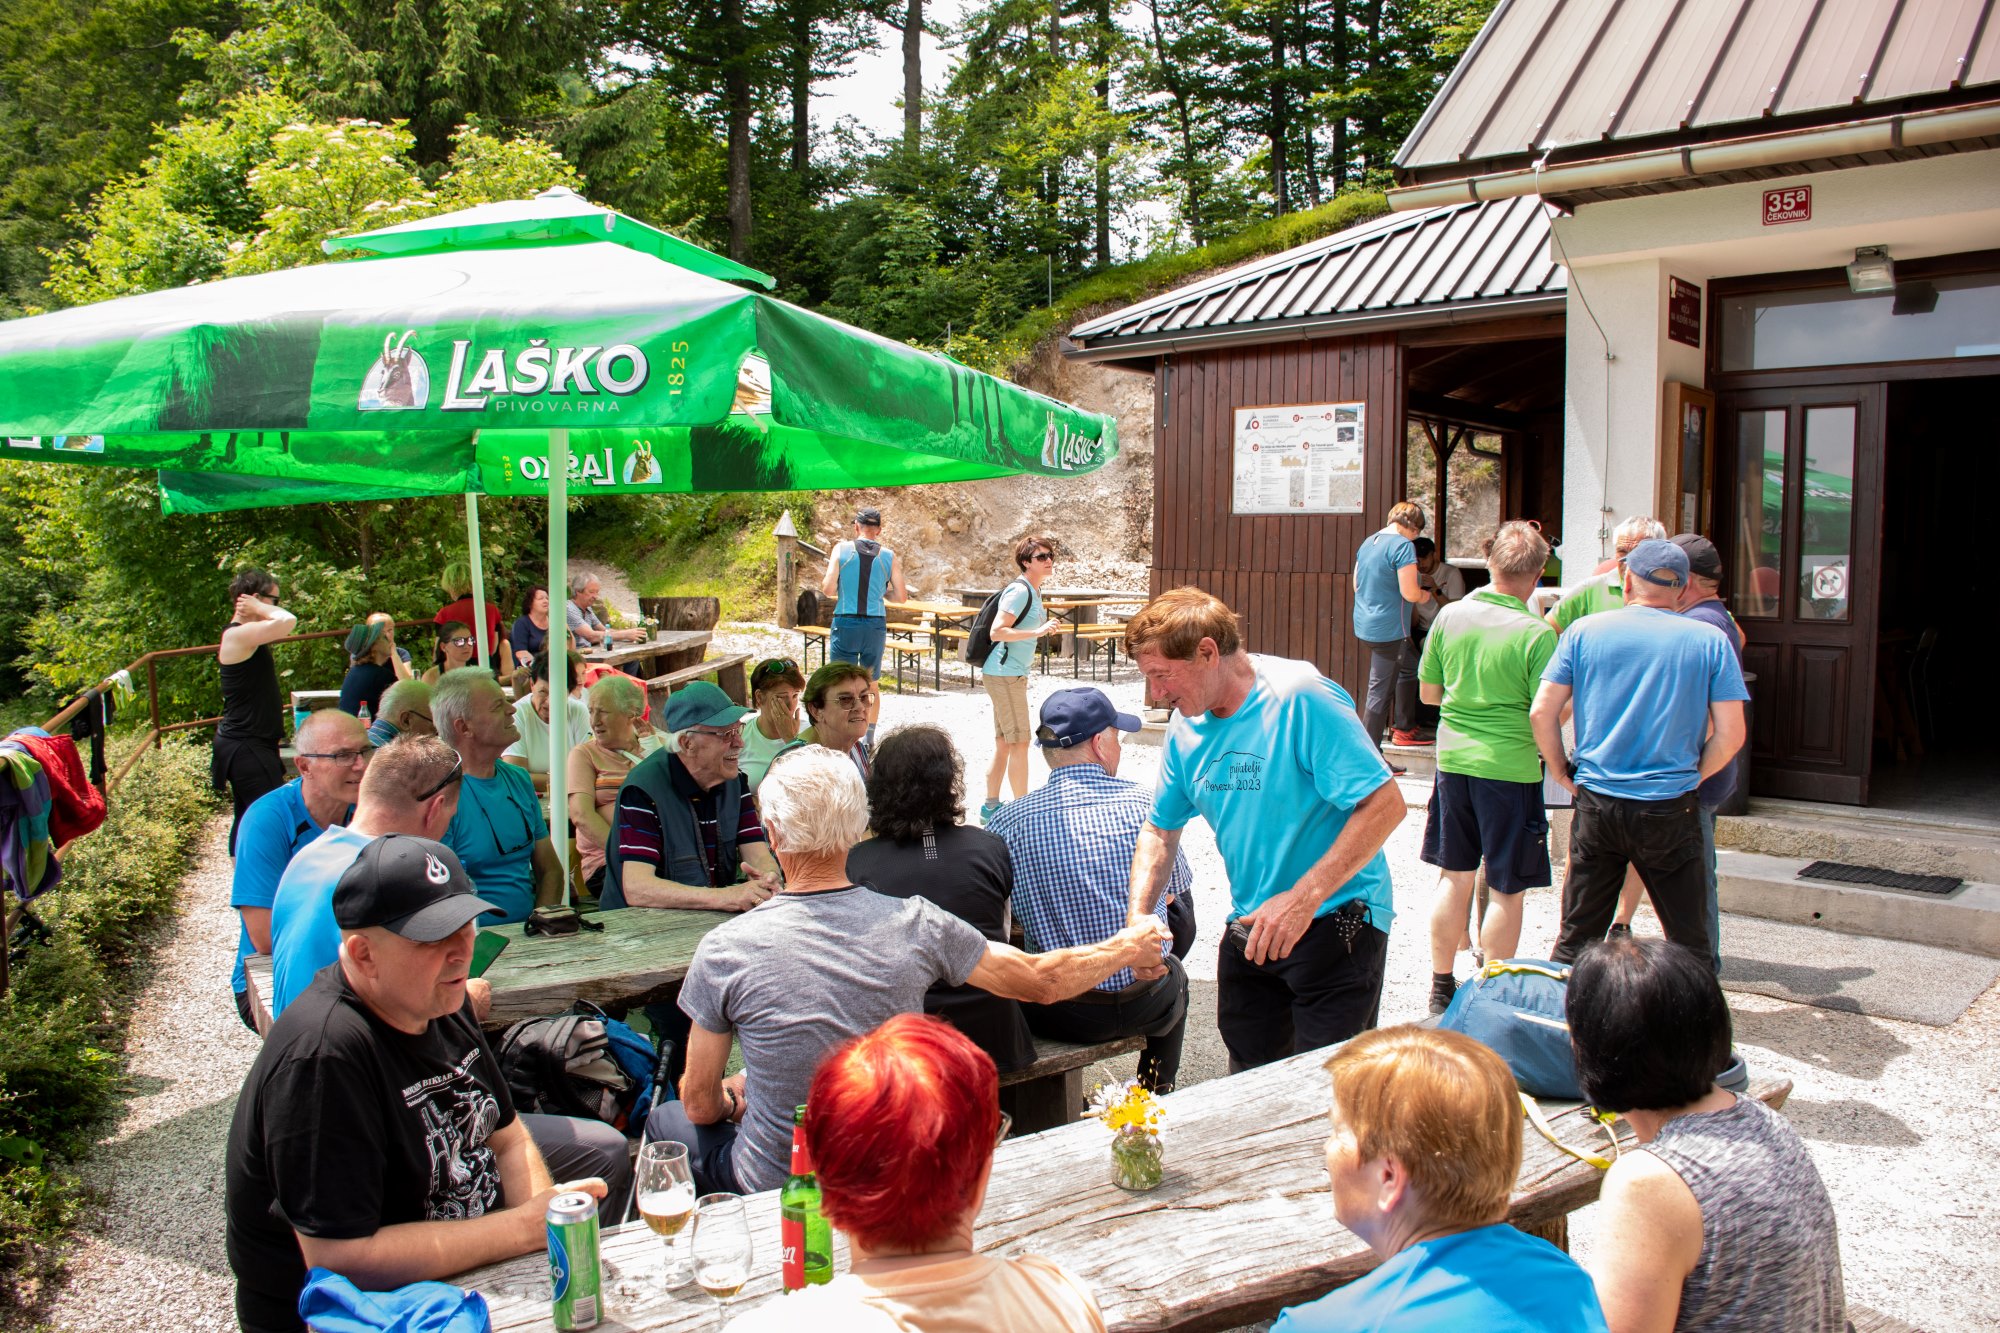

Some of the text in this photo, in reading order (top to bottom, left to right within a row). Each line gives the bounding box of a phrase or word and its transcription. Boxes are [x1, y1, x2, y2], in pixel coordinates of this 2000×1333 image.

[1768, 190, 1806, 212] 35a
[1767, 209, 1806, 221] ČEKOVNIK
[440, 339, 650, 413] LAŠKO
[667, 341, 690, 397] 1825
[496, 401, 620, 413] PIVOVARNA
[1236, 779, 1261, 790] 2023
